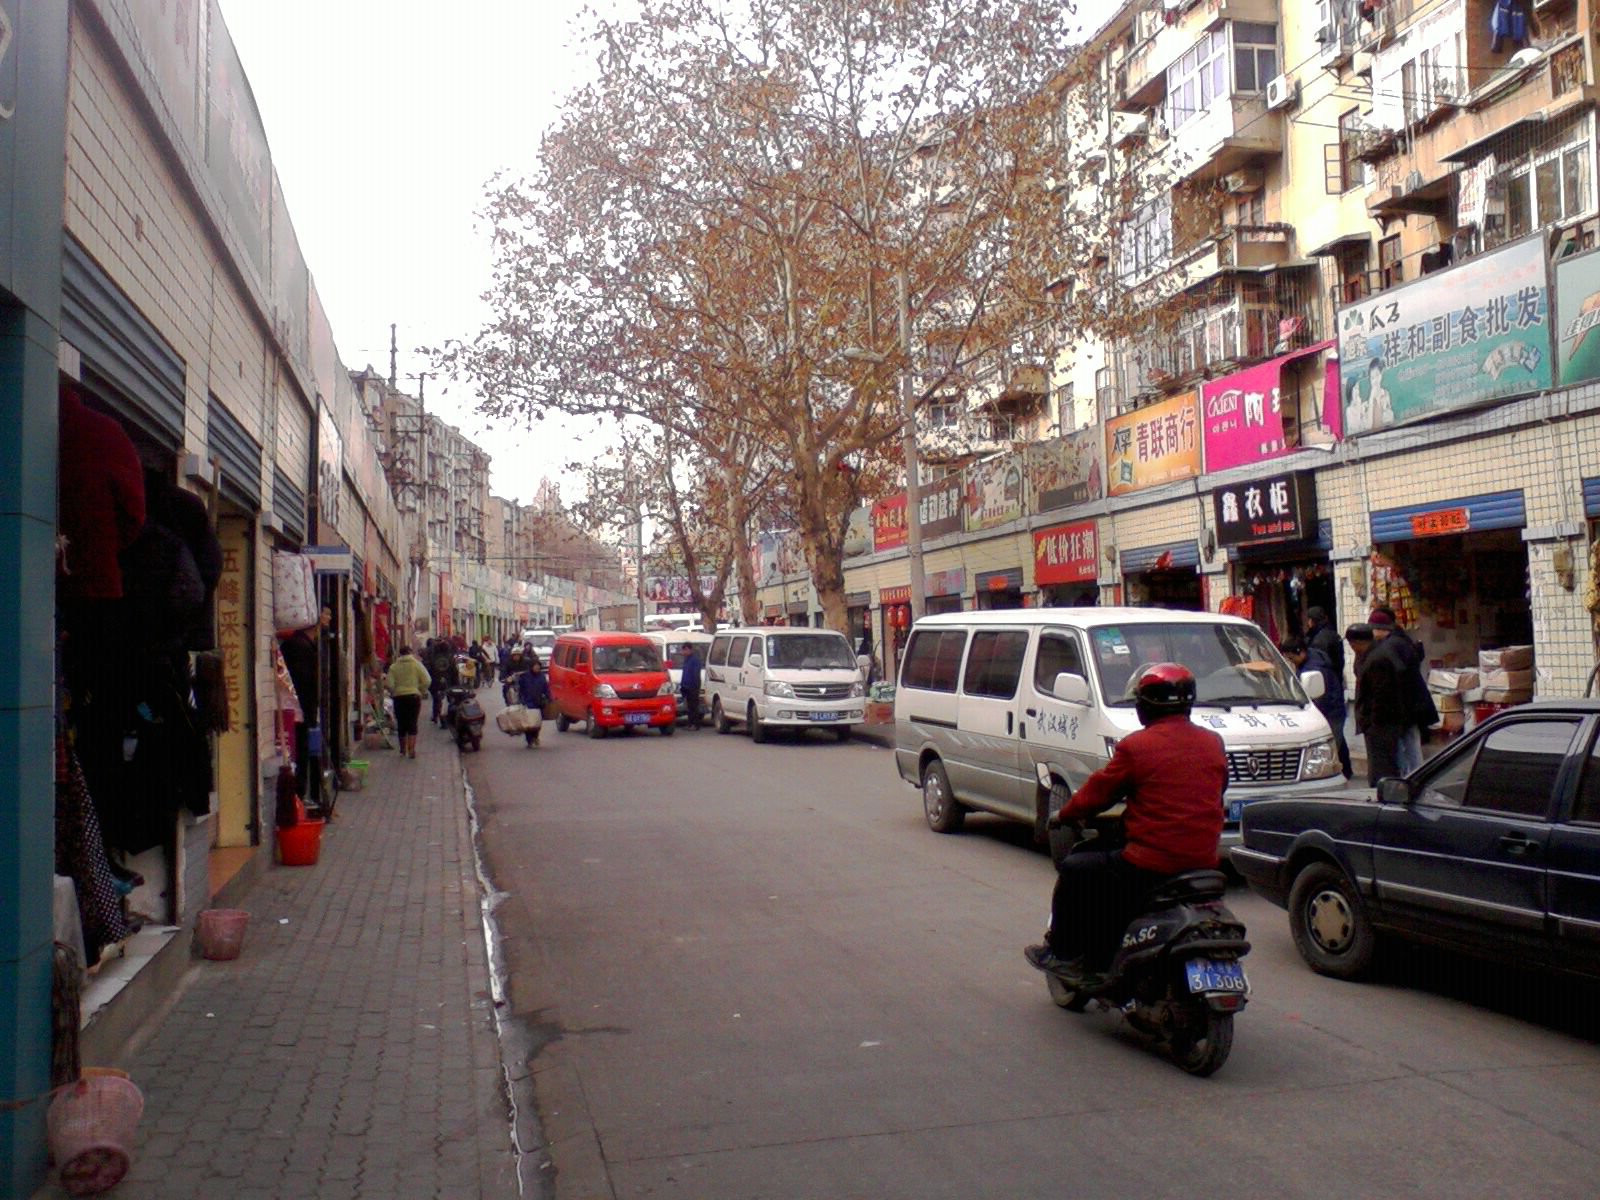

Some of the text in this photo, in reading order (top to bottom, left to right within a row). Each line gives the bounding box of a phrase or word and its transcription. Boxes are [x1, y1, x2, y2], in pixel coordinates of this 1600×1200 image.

[1384, 285, 1542, 369] 祥和副食批发
[1136, 407, 1195, 463] 青联商行
[1222, 481, 1289, 523] 鑫衣柜
[1047, 529, 1095, 566] 低价狂潮
[1037, 708, 1080, 740] 武汉城管
